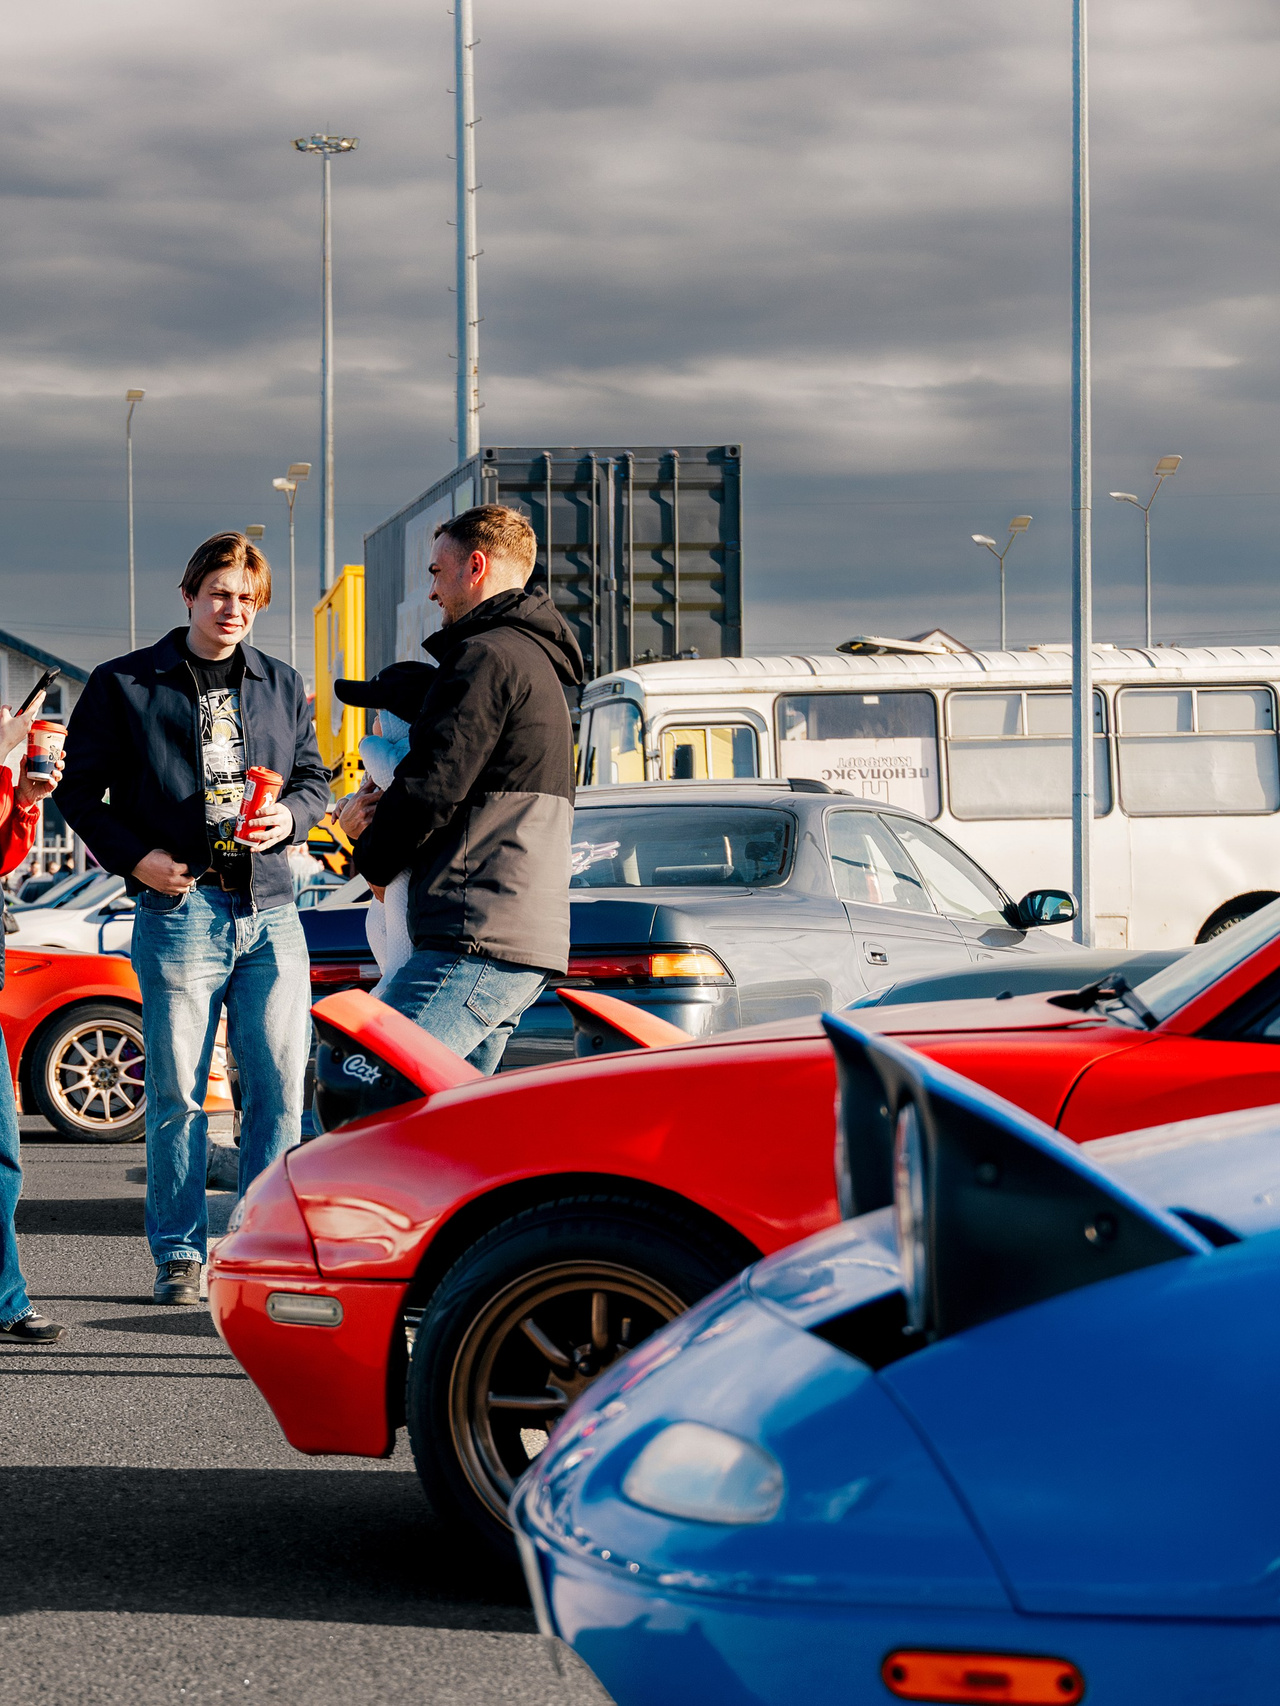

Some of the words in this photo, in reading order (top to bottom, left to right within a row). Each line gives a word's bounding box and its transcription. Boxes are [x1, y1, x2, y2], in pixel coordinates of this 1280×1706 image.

[837, 756, 911, 769] КОМФОРТ
[821, 767, 929, 780] ПЕНОПЛЭКС
[214, 840, 238, 851] OIL
